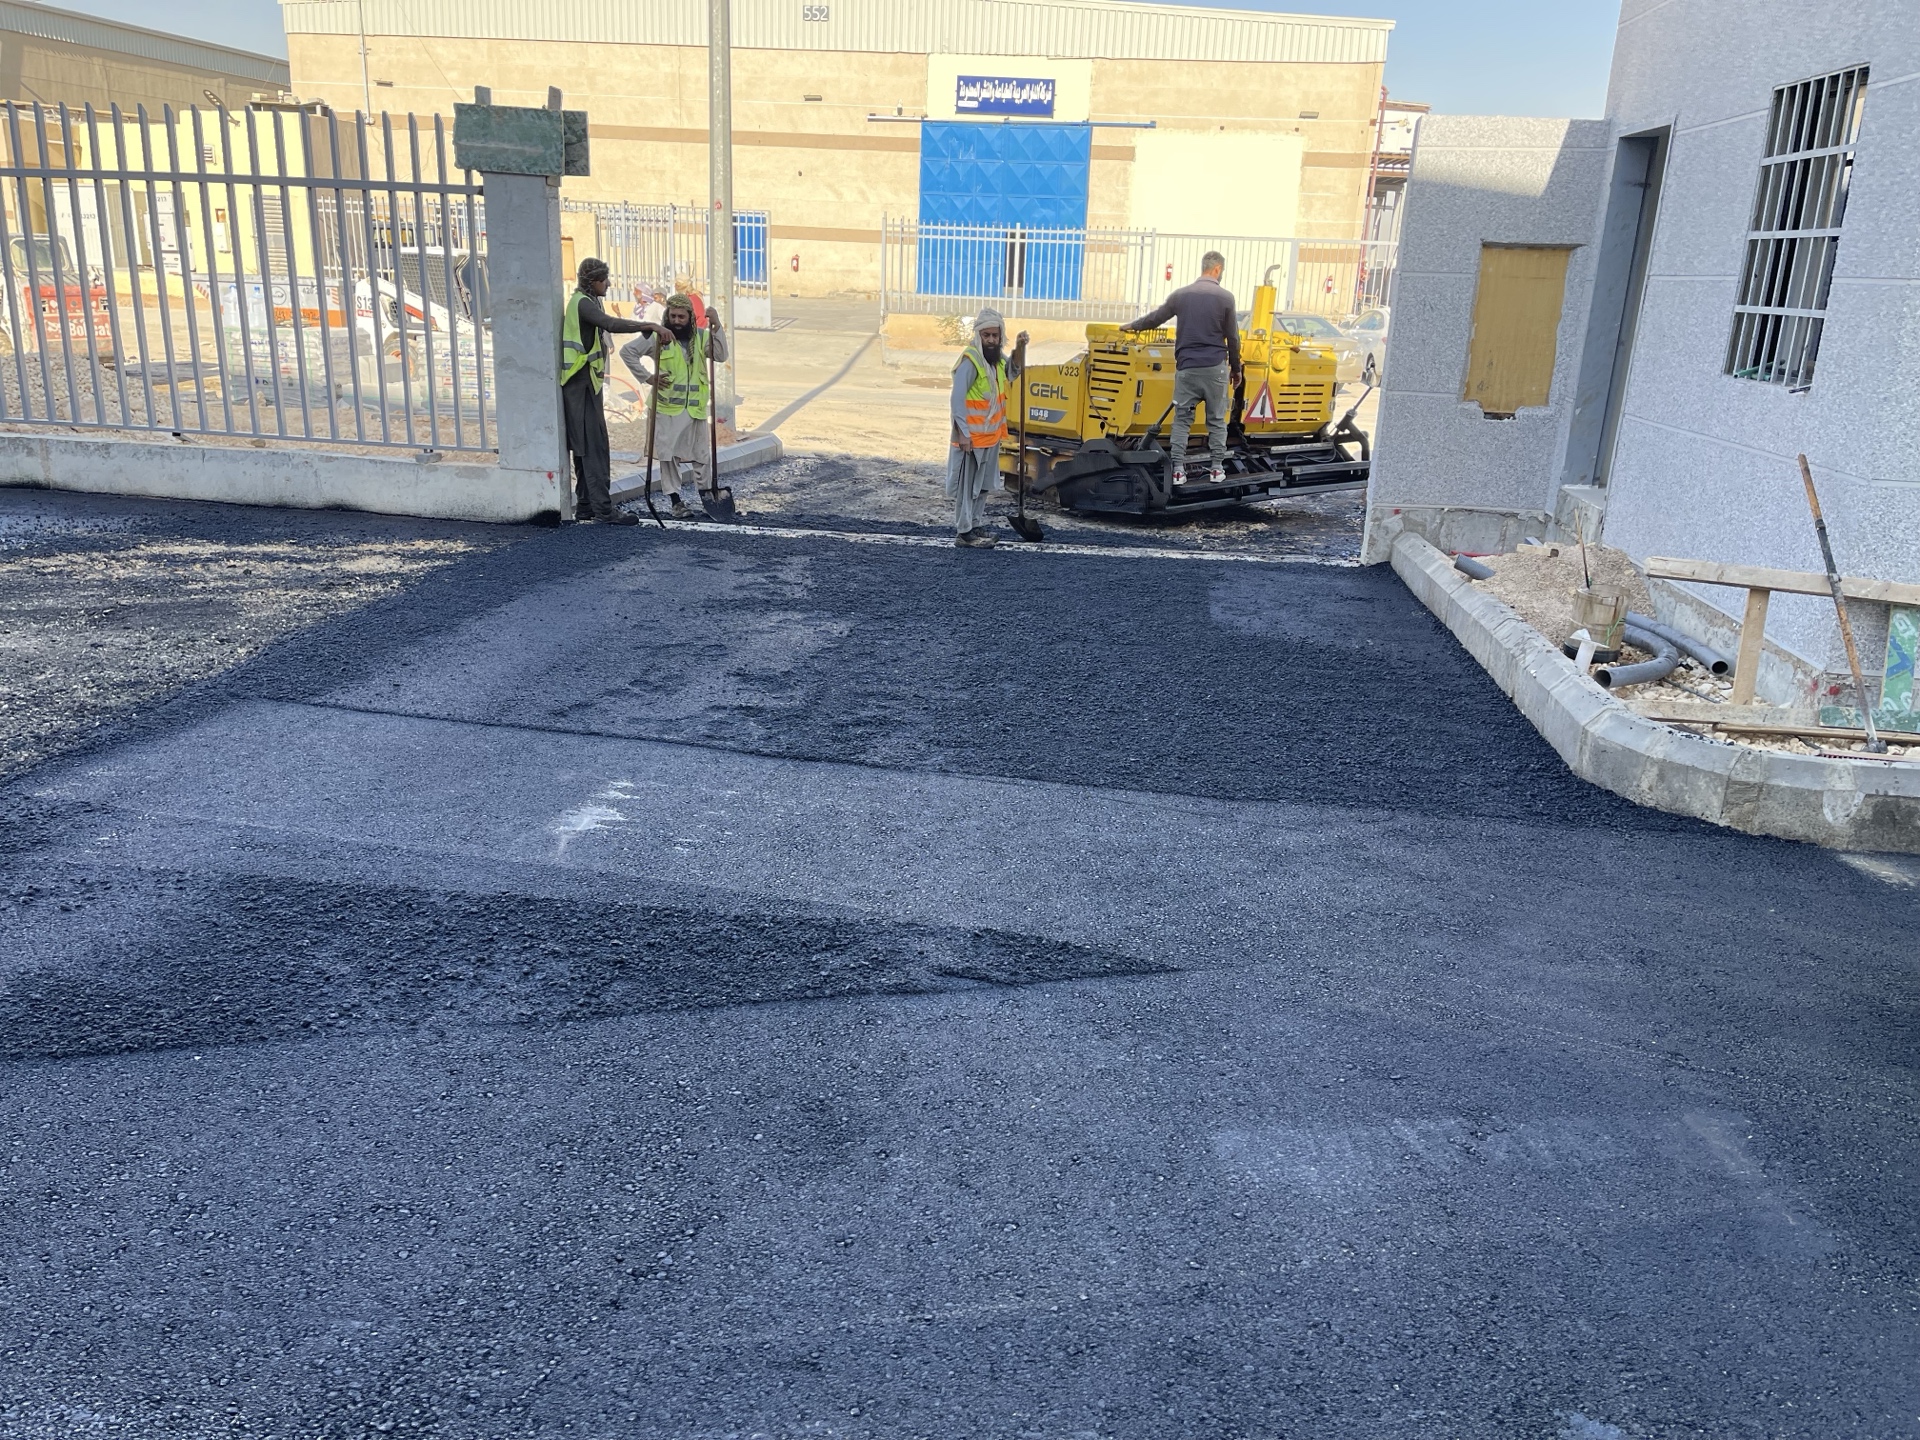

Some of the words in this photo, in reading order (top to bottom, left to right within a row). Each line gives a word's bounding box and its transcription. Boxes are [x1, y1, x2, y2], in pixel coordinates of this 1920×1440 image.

[804, 6, 828, 20] 552
[1039, 81, 1052, 104] شركة
[1029, 382, 1069, 400] GEHL
